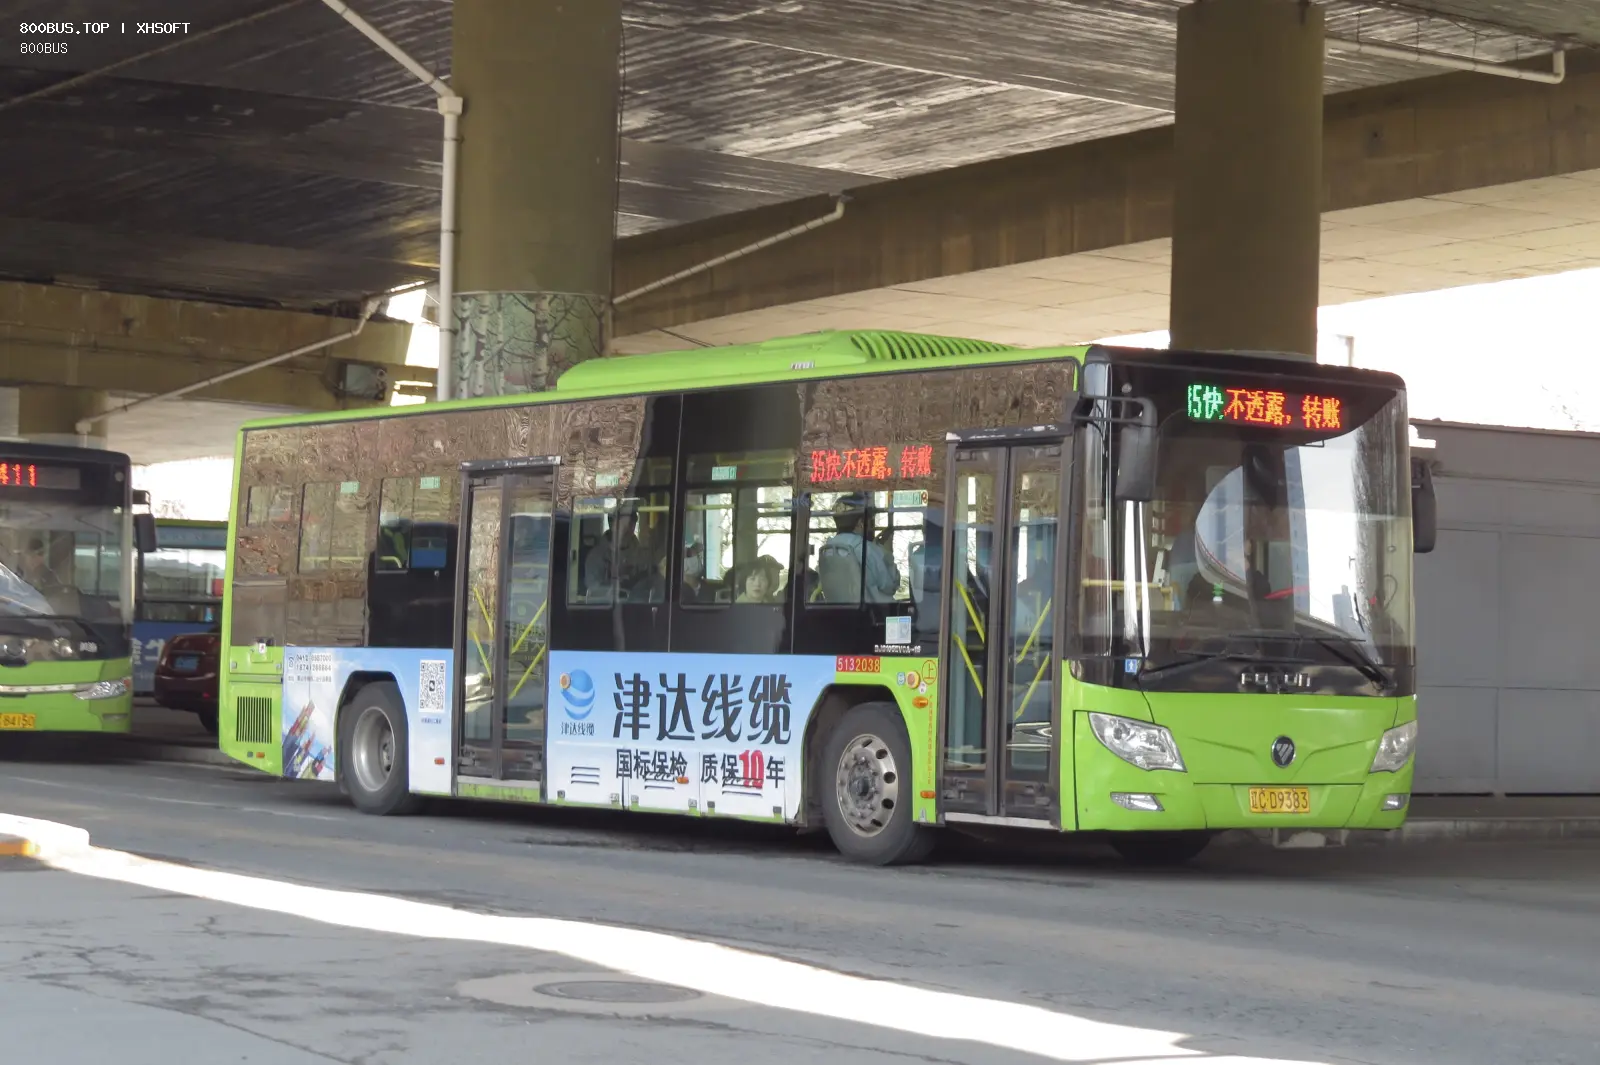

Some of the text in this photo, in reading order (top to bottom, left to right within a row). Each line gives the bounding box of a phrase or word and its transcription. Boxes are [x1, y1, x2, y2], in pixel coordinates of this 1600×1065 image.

[837, 657, 880, 673] 5132038
[923, 662, 935, 680] 上
[612, 672, 793, 745] 津达线缆
[560, 721, 595, 738] 津达线缆
[615, 749, 688, 780] 国标保检
